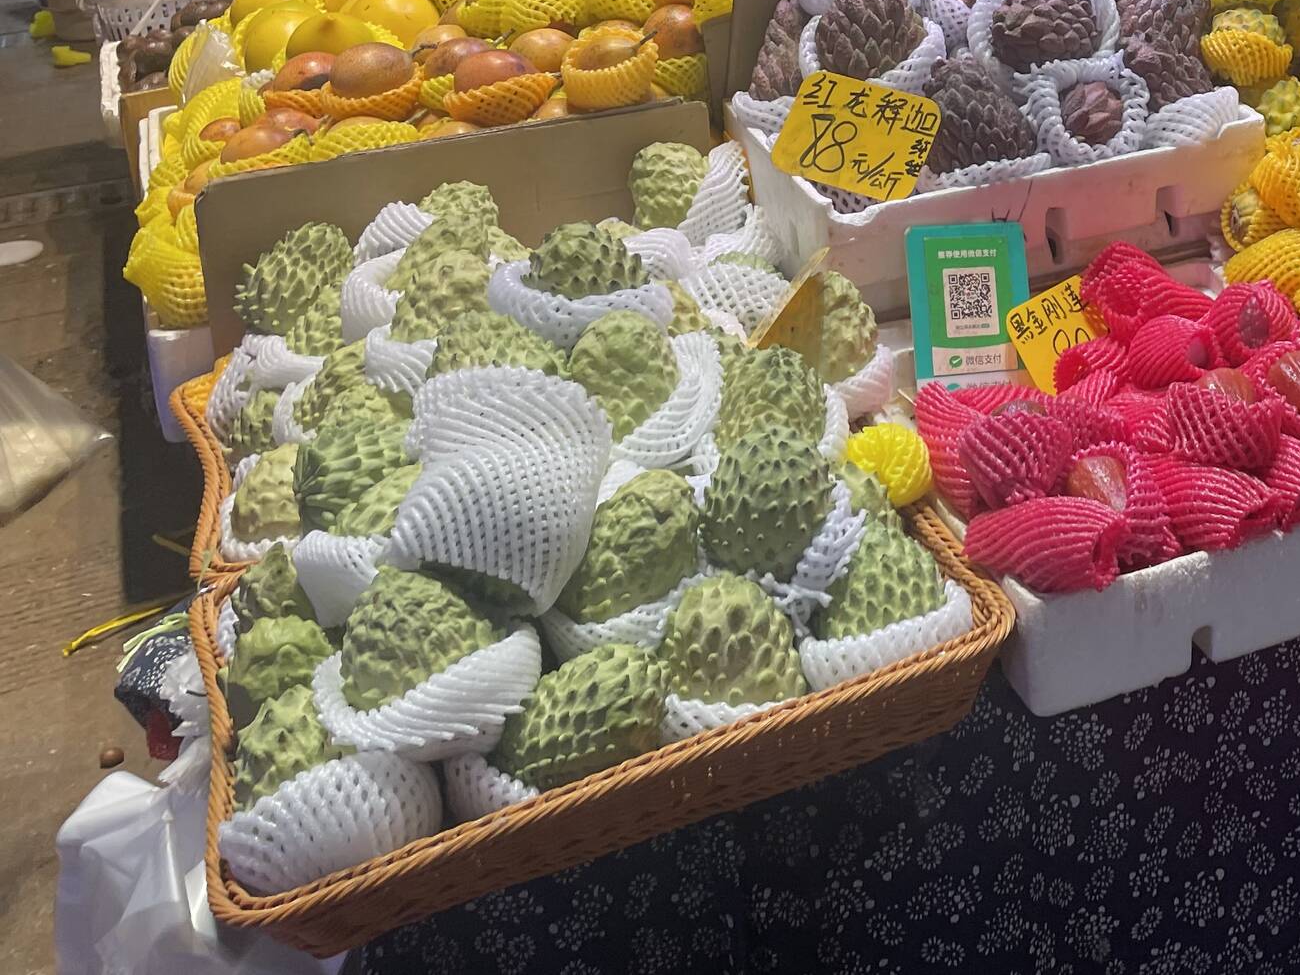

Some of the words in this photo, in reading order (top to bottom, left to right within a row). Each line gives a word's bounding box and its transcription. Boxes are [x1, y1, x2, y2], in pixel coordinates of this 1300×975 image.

[803, 74, 938, 137] 红龙释迦
[937, 248, 997, 260] 推荐使用微信支付
[966, 353, 1001, 366] 微信支付
